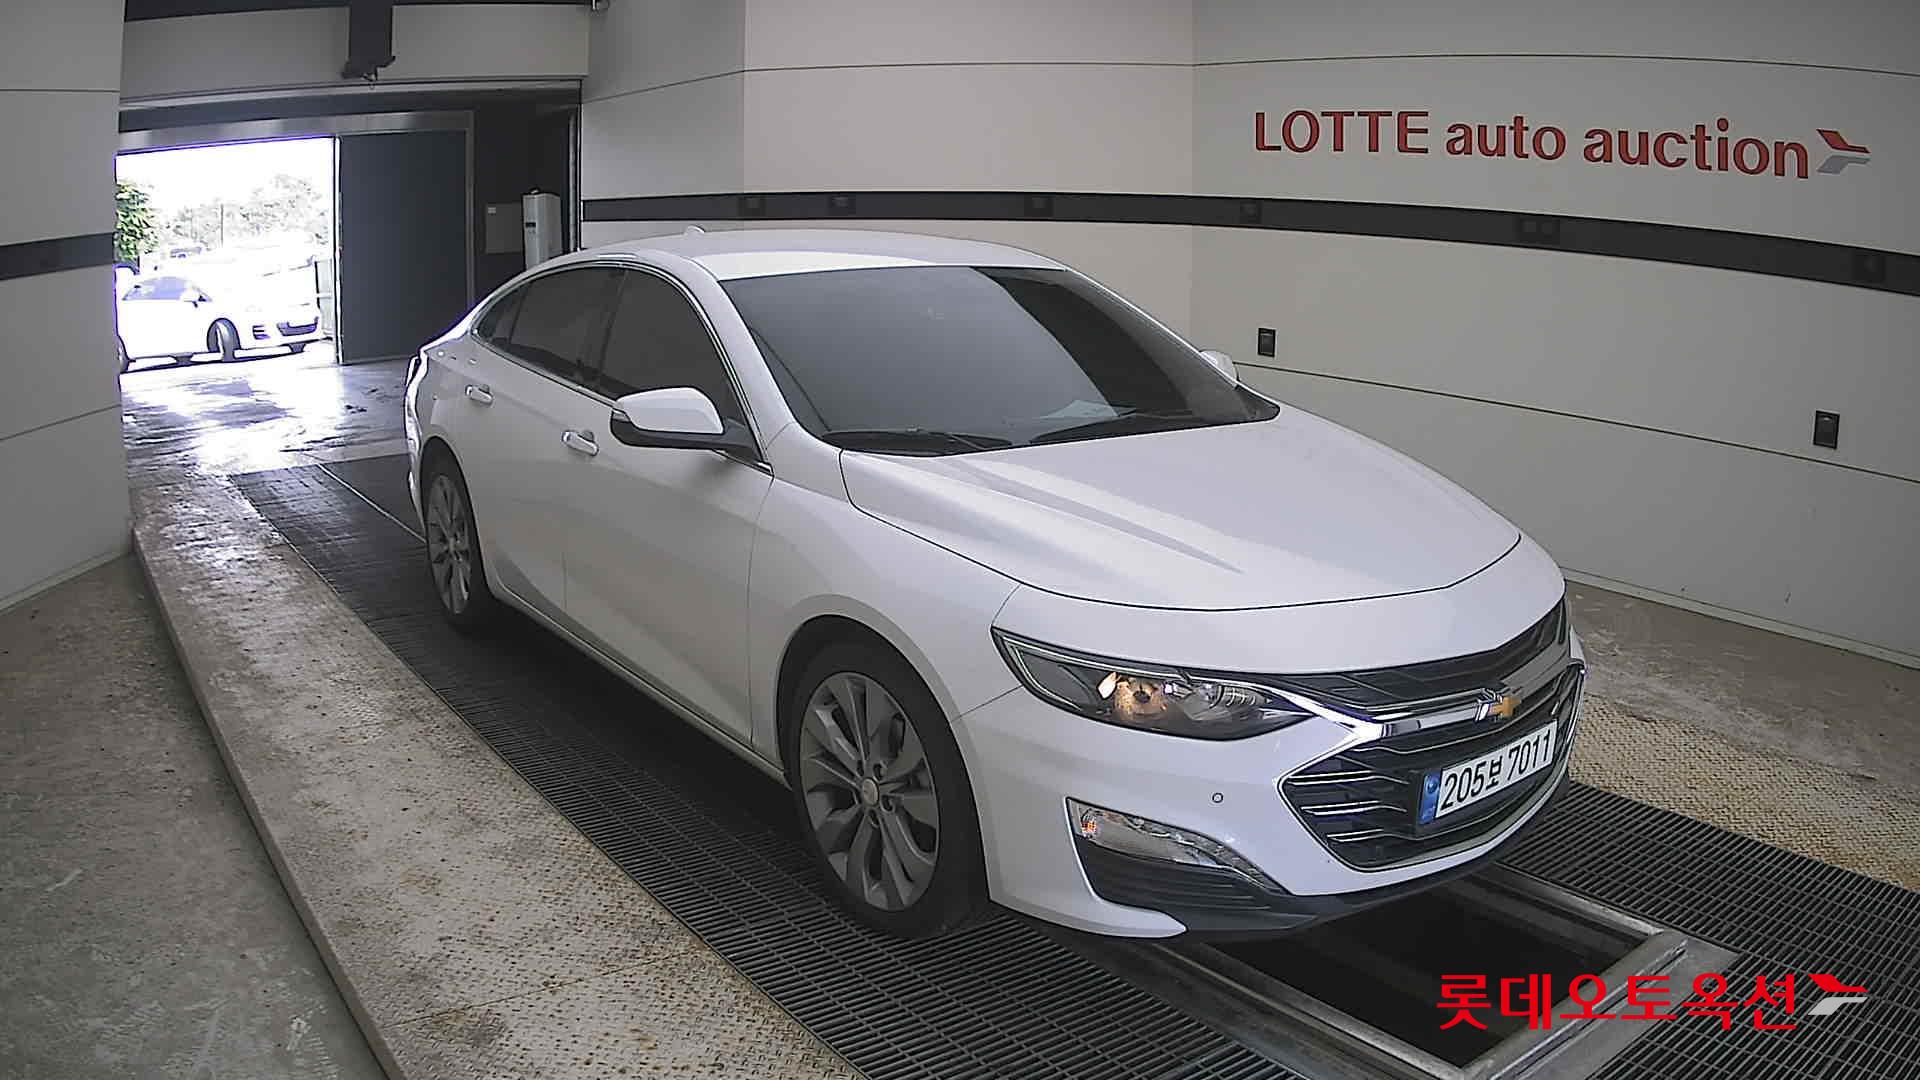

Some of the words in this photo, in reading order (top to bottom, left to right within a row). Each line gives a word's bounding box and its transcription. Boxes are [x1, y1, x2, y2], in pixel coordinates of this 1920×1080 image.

[1254, 110, 1430, 154] LOTTE
[1446, 115, 1567, 160] auto
[1583, 118, 1809, 179] auction
[1507, 729, 1551, 781] 7011
